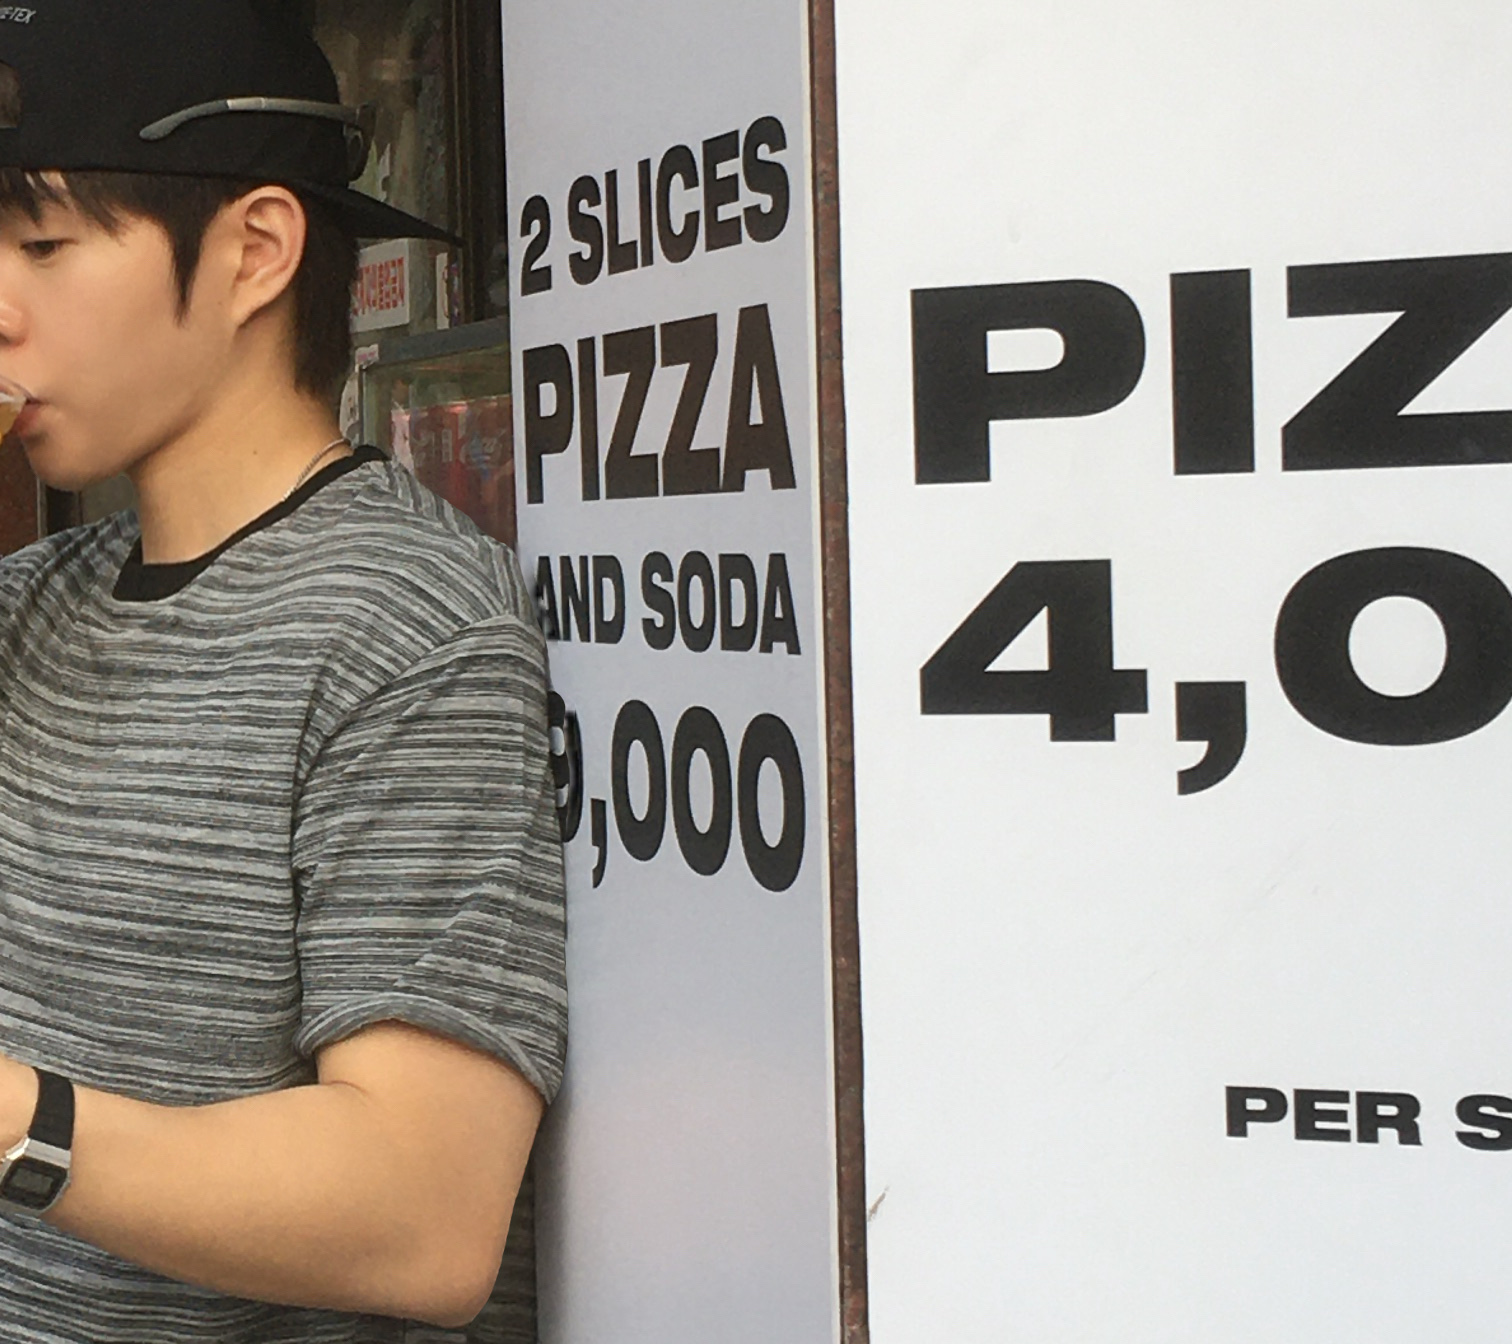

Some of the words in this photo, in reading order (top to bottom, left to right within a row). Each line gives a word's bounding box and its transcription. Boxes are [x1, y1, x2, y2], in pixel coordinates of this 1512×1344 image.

[520, 195, 552, 296] 2
[567, 116, 790, 285] SLICES
[522, 303, 797, 505] PIZZA
[910, 252, 1512, 485] PIZ
[536, 555, 625, 644] AND
[640, 550, 802, 655] SODA
[920, 546, 1512, 795] 4,0
[1225, 1086, 1423, 1146] PER
